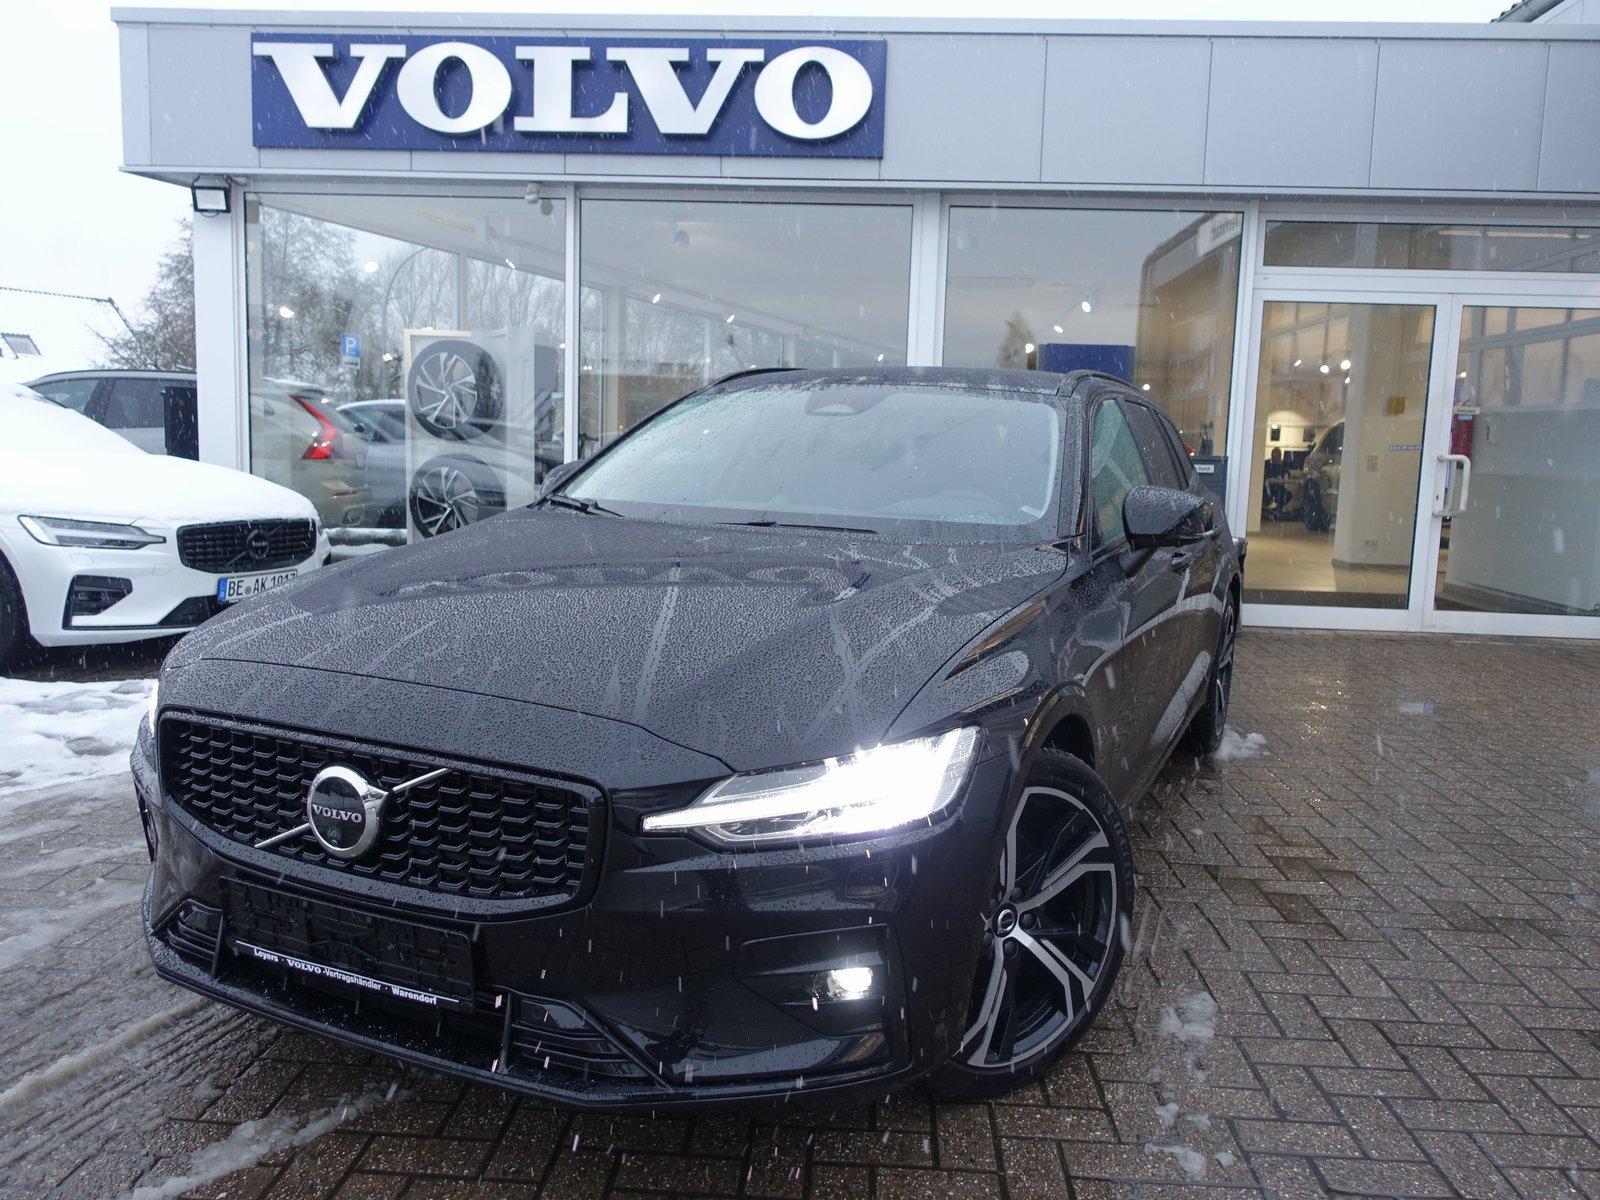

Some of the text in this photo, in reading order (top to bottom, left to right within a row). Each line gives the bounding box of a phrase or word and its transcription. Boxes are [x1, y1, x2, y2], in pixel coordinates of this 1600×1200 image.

[252, 40, 874, 140] VOLVO
[346, 336, 356, 354] P
[228, 580, 245, 597] BE
[253, 577, 268, 594] AK
[312, 803, 362, 823] VOLVO
[254, 947, 279, 963] Leyers
[286, 958, 322, 974] VOLVO
[391, 985, 437, 1005] Warendorf
